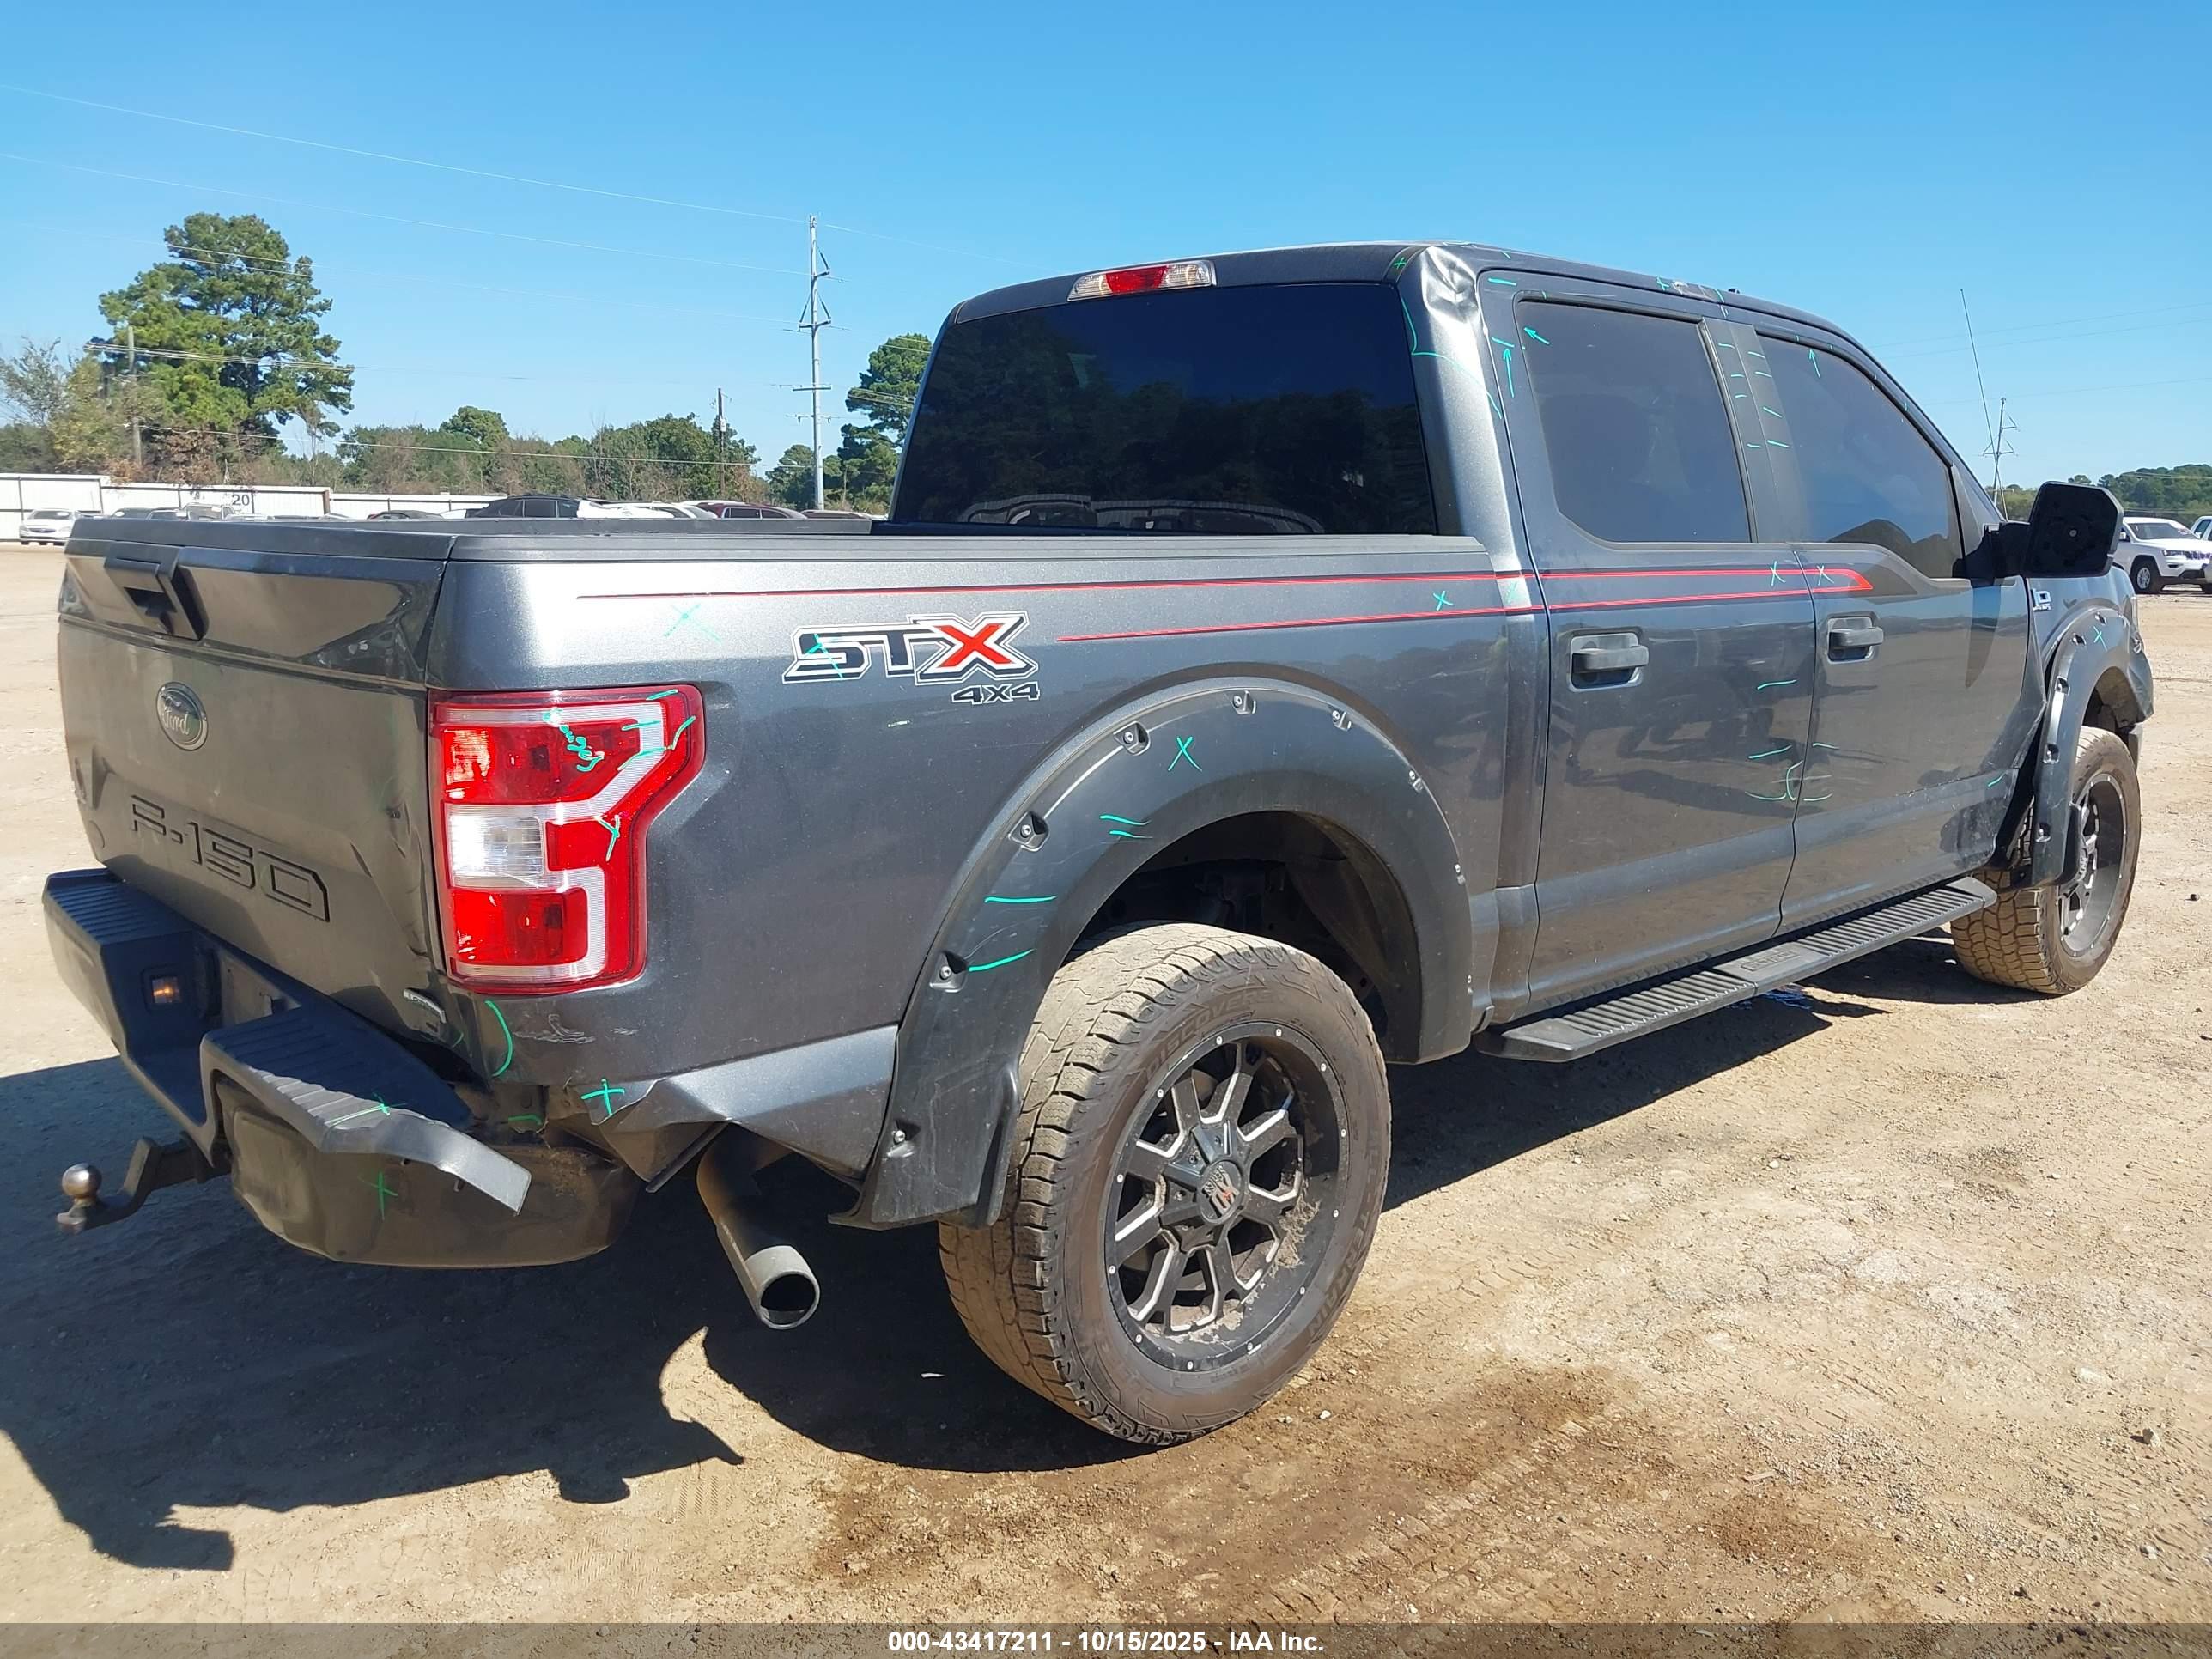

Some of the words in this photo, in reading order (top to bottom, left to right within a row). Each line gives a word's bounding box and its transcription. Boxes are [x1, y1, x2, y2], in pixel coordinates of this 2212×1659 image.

[232, 494, 250, 507] 20
[782, 610, 1039, 685] STX
[130, 794, 331, 923] F-150
